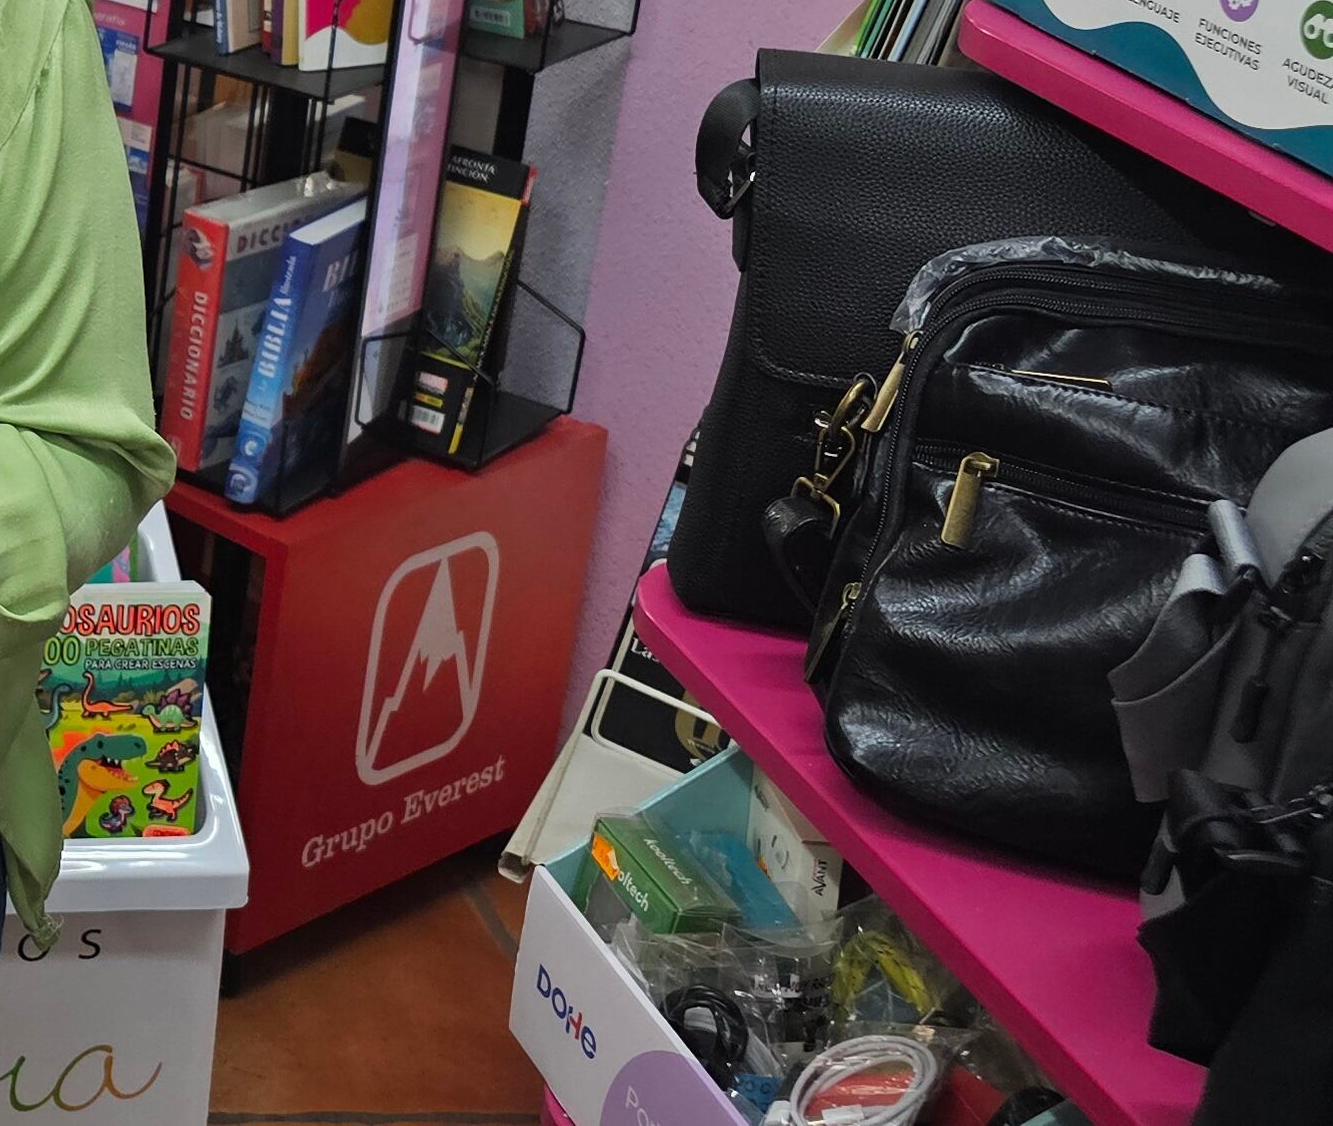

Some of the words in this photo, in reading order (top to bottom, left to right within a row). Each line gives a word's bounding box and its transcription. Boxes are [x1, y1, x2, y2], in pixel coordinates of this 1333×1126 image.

[1195, 33, 1260, 72] EJECUTIVAS
[1199, 18, 1262, 56] FUNCIONES
[1287, 76, 1329, 105] VISUAL
[181, 291, 207, 421] DICCIONARIO
[258, 296, 292, 379] BIBLIA
[85, 637, 199, 658] PEGATINAS
[85, 658, 112, 671] PARA
[114, 658, 149, 670] CREAR
[152, 658, 197, 670] ESCENAS
[301, 807, 395, 869] Grupo
[401, 755, 507, 826] Everest
[812, 859, 830, 896] AVANT
